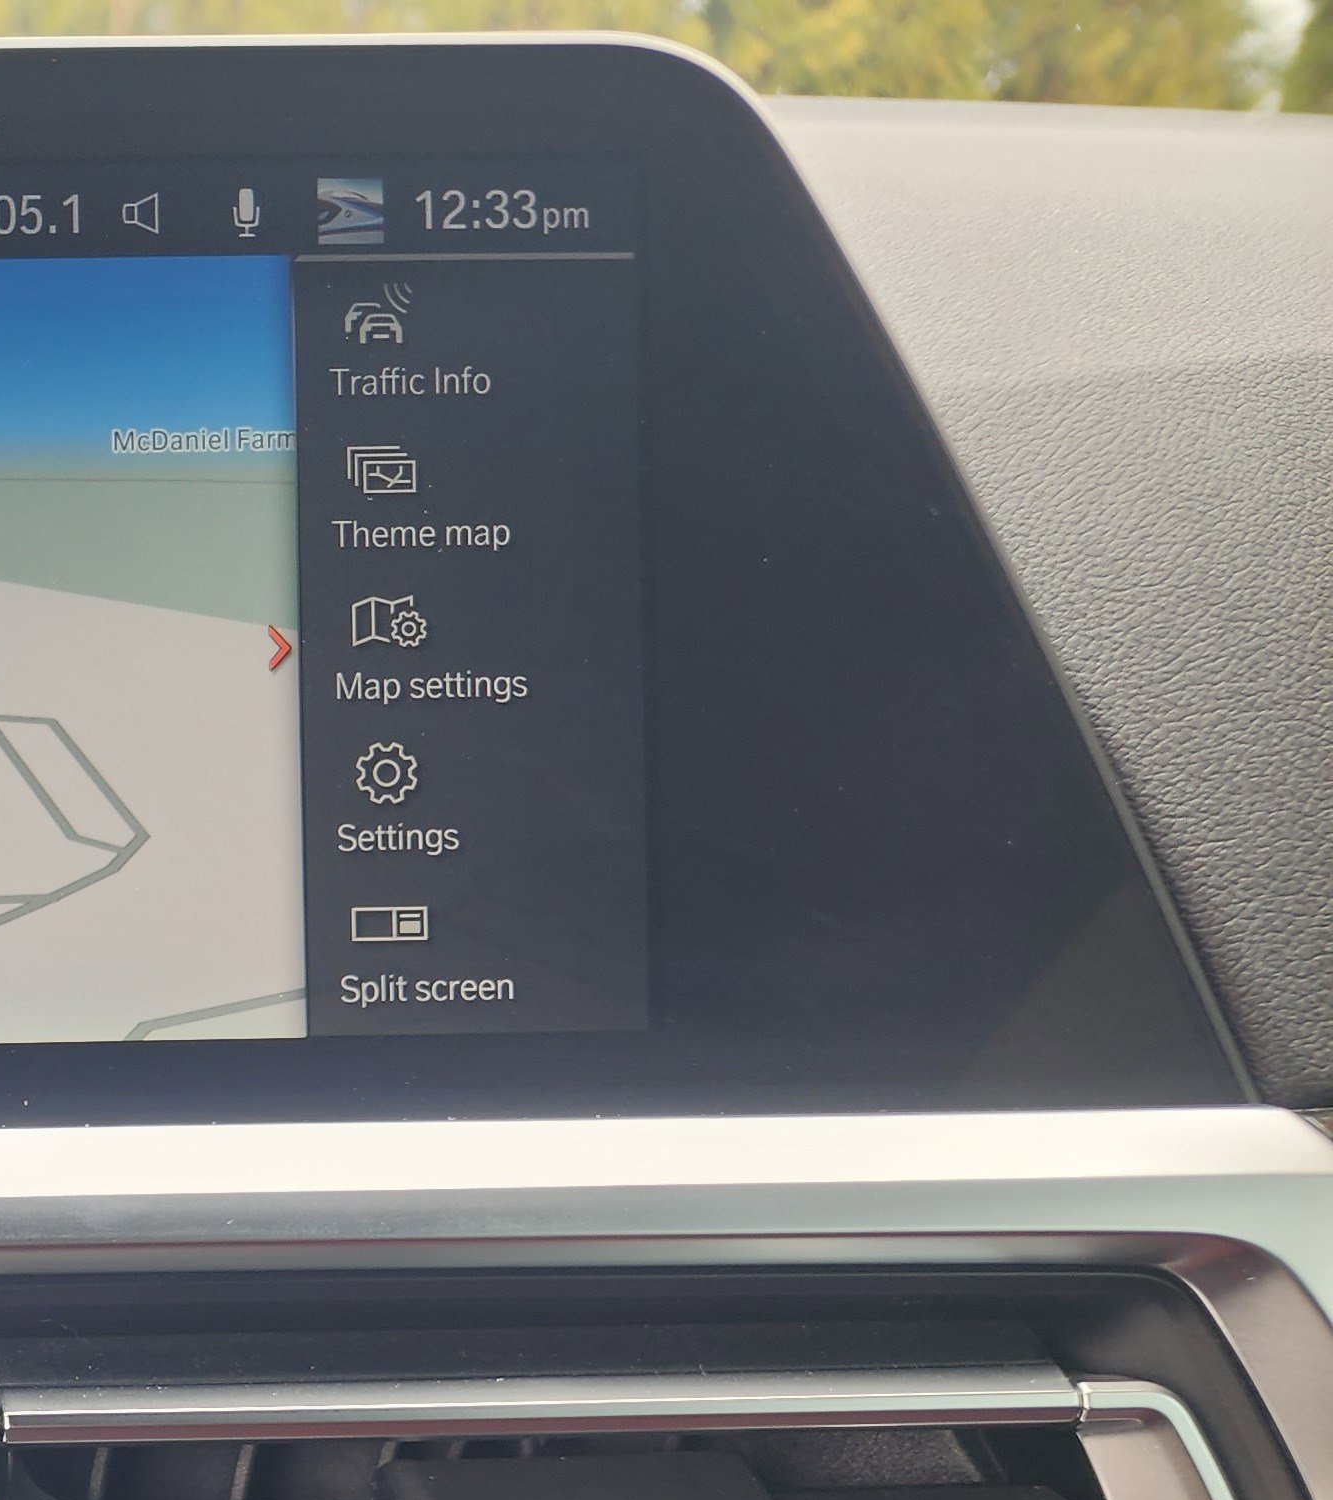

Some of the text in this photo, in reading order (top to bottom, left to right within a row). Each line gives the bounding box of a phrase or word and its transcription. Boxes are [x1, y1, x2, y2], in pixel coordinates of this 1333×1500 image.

[329, 365, 491, 396] Traffic Info
[113, 428, 296, 451] McDaniel Farm
[331, 519, 511, 553] Theme map
[336, 669, 528, 705] Map settings
[337, 822, 460, 856] Settings
[340, 974, 514, 1008] Split screen
